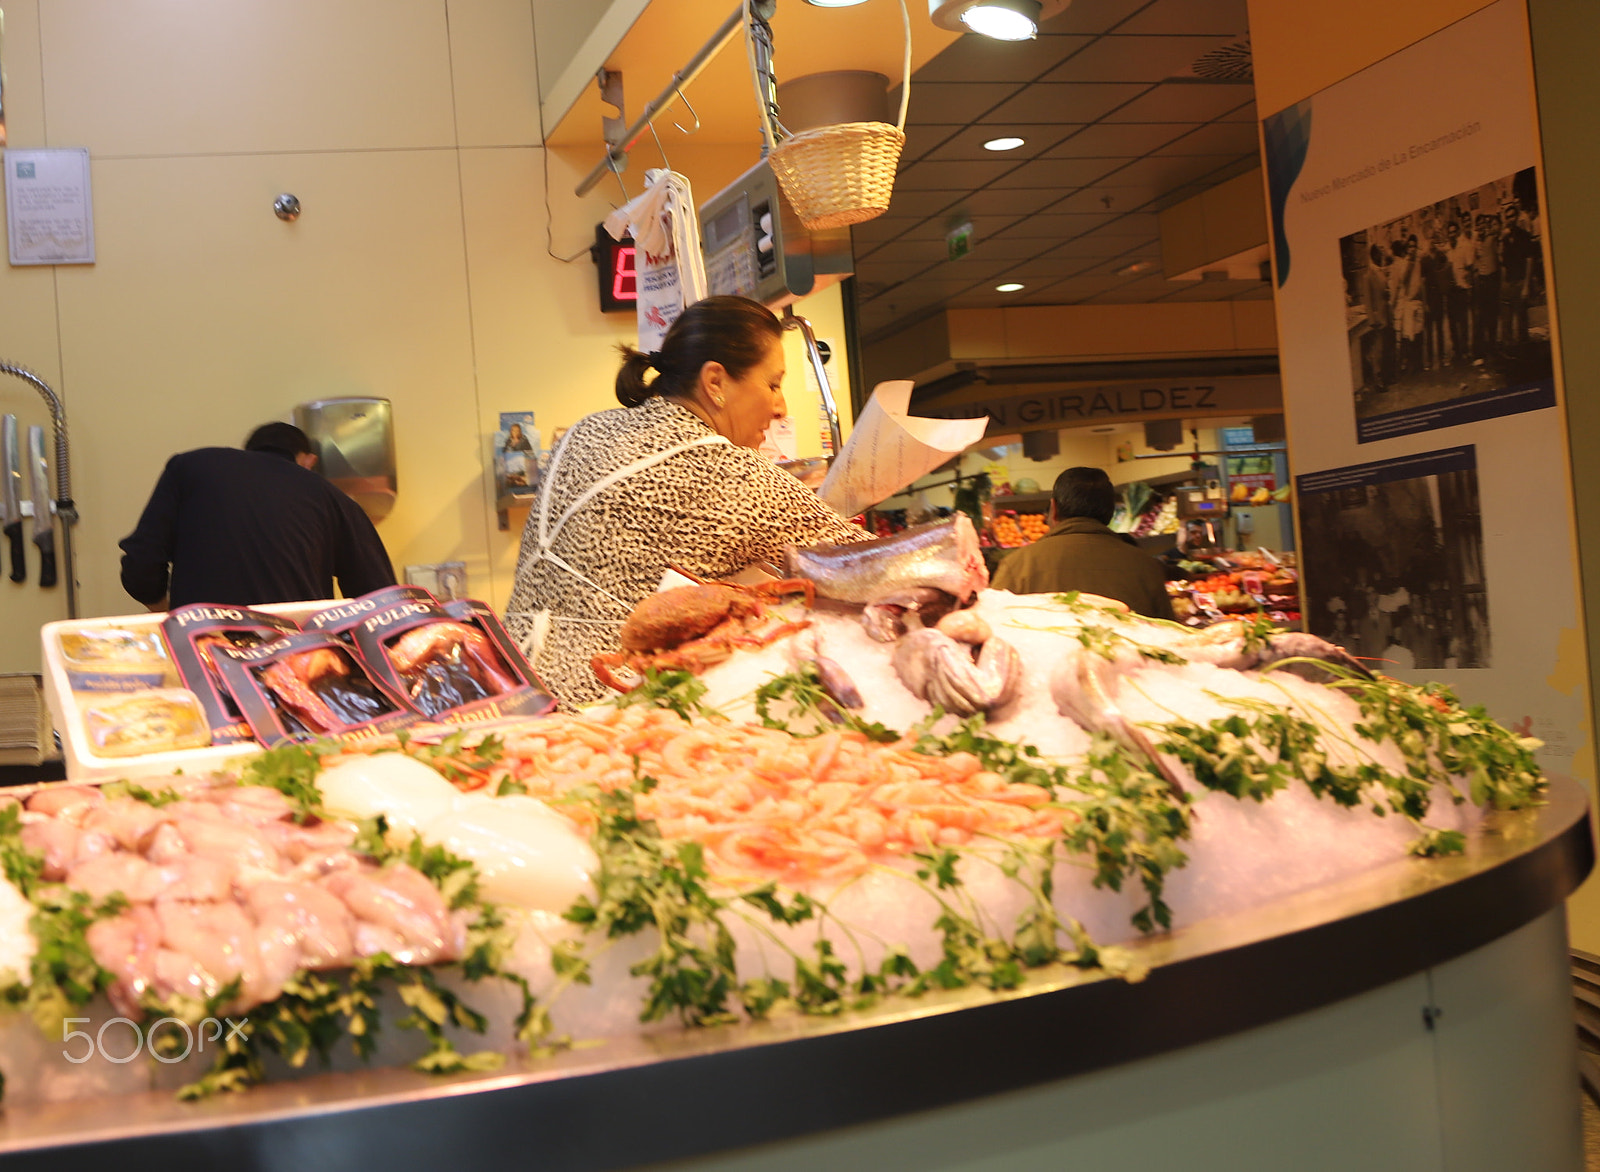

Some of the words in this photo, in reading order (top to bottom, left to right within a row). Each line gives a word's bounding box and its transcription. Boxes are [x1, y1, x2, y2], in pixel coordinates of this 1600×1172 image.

[1300, 184, 1331, 204] Nuevo
[1331, 165, 1376, 191] Mercado
[1376, 157, 1391, 173] de
[1392, 152, 1408, 166] La
[1408, 120, 1481, 160] Encarnación
[175, 607, 244, 627] PULPO
[311, 599, 377, 629] PULPO
[364, 603, 431, 633] PULPO
[224, 639, 292, 660] PULPO
